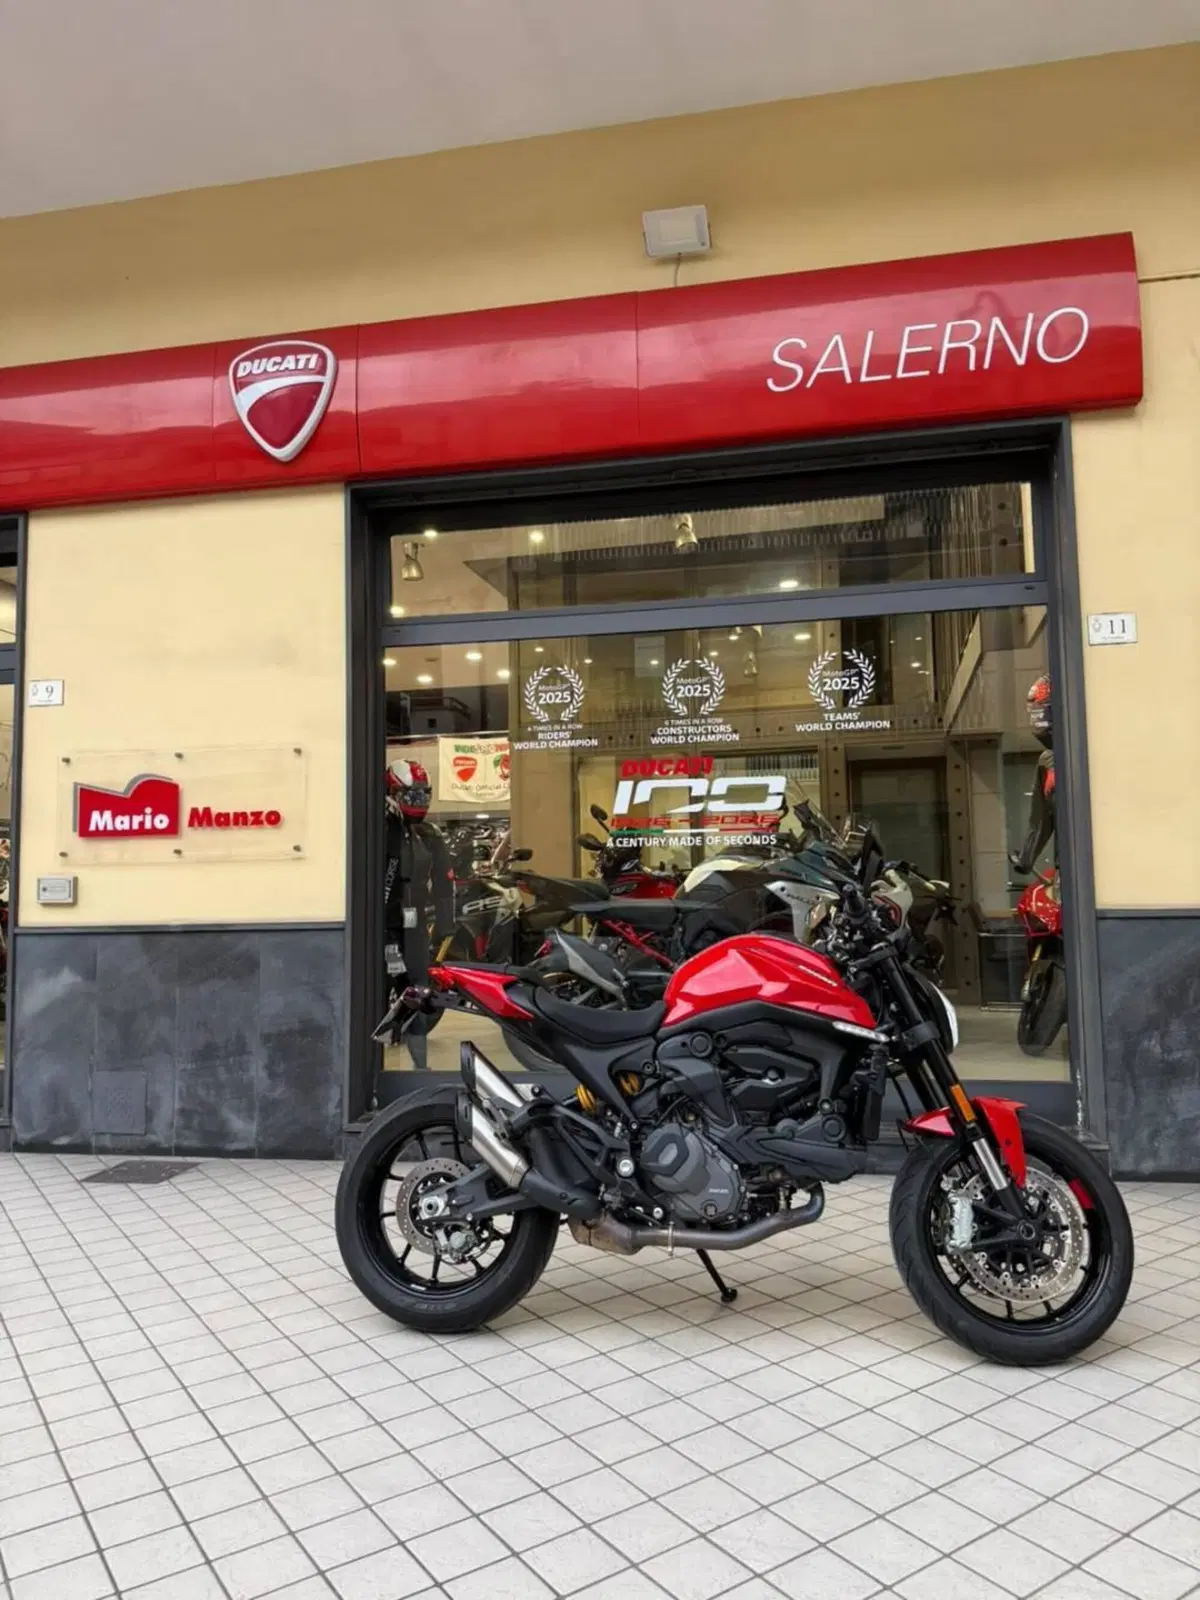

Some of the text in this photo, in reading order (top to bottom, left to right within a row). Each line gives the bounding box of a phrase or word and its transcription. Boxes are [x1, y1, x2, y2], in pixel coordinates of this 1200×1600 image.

[766, 306, 1089, 393] SALERNO
[236, 353, 319, 378] DUCATI
[1109, 619, 1126, 634] 11
[676, 684, 711, 698] 2025
[822, 677, 860, 691] 2025
[45, 684, 54, 699] 9
[538, 691, 571, 704] 2025
[795, 720, 891, 732] WORLD CHAMPION
[513, 740, 547, 750] WORLD
[549, 739, 598, 749] CHAMPION
[650, 733, 740, 744] WORLD CHAMPION
[621, 756, 715, 778] DUCATI
[88, 806, 281, 831] Mario Manzo
[606, 834, 777, 848] A CENTURY MADE OF SECONDS
